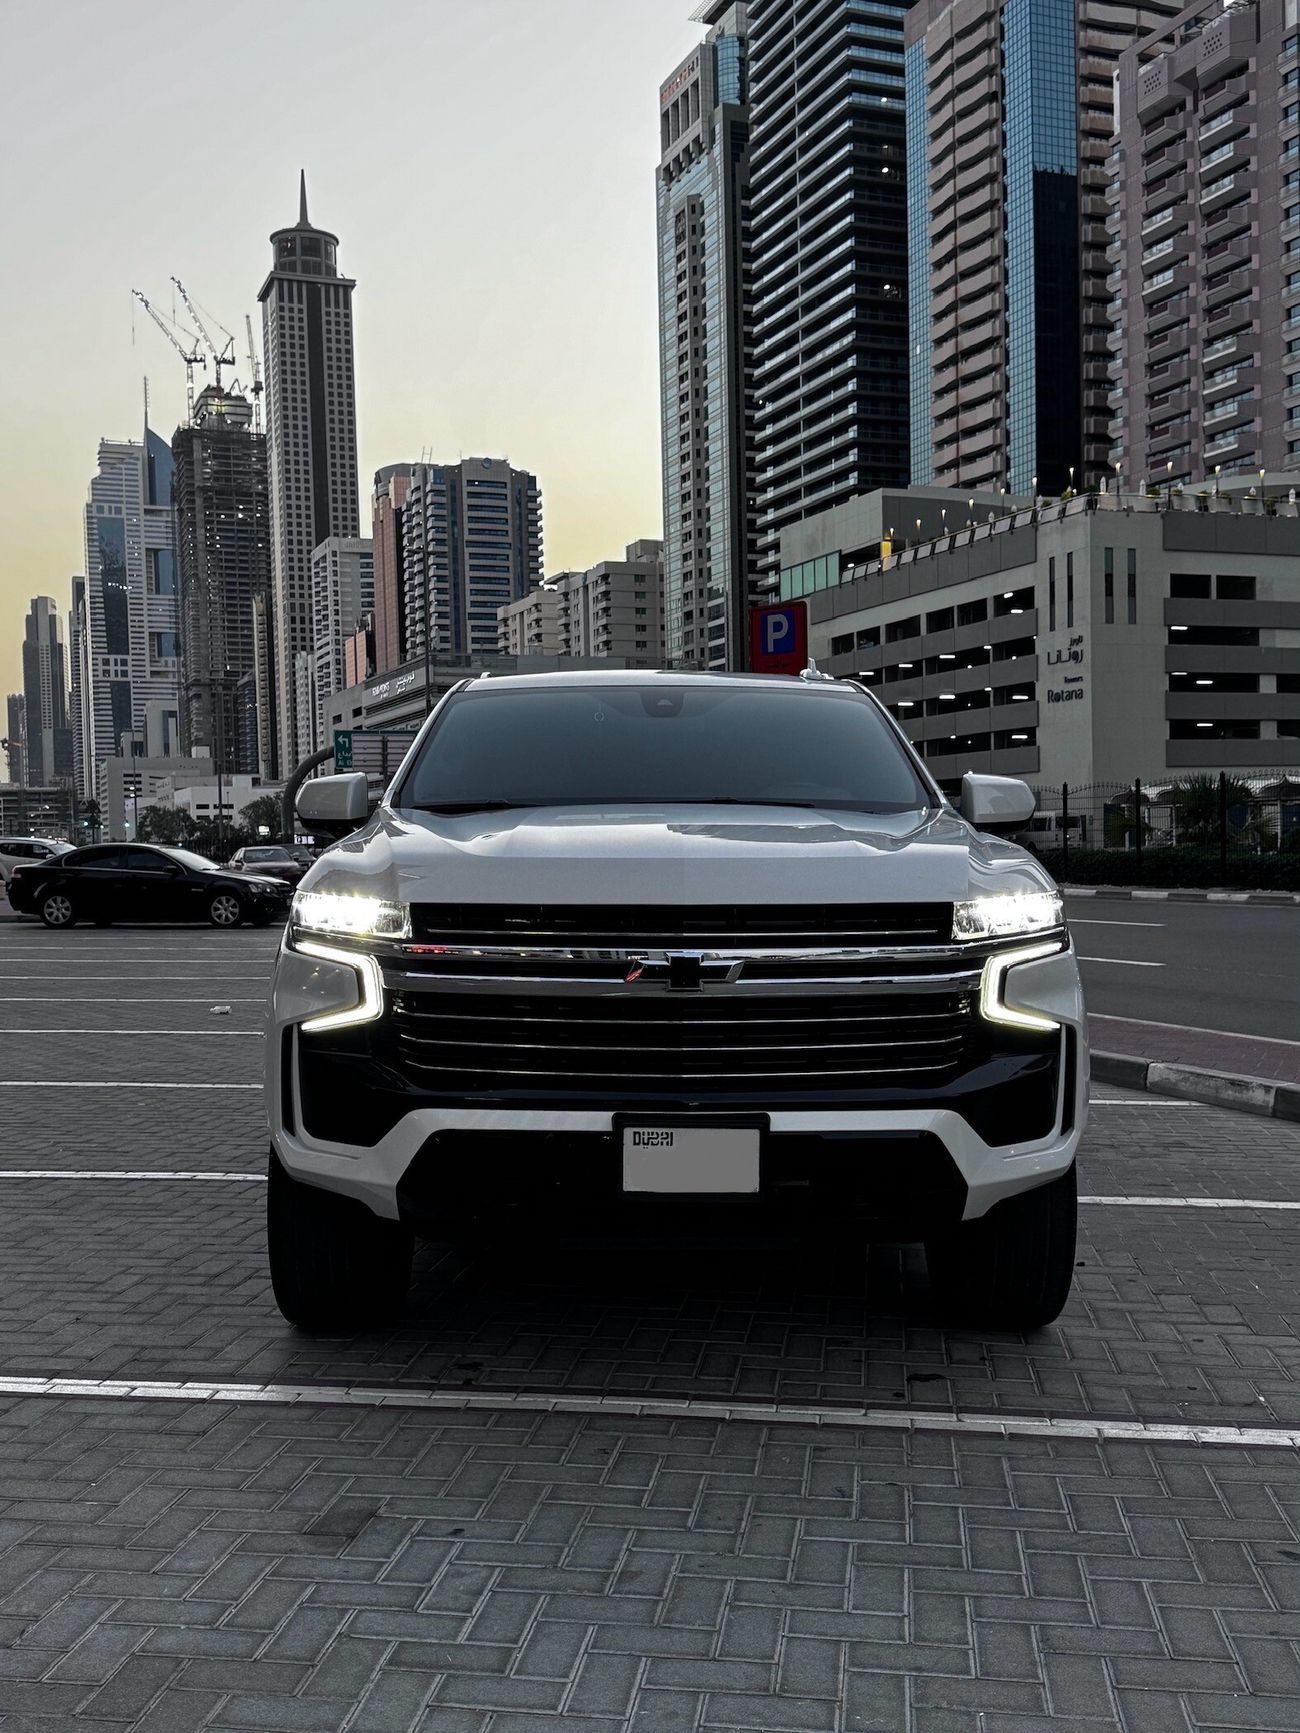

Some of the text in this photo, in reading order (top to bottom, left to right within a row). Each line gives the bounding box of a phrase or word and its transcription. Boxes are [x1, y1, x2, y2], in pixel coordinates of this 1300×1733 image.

[767, 614, 789, 653] P
[1047, 688, 1084, 704] Rotana
[632, 1131, 674, 1147] DUBAI
